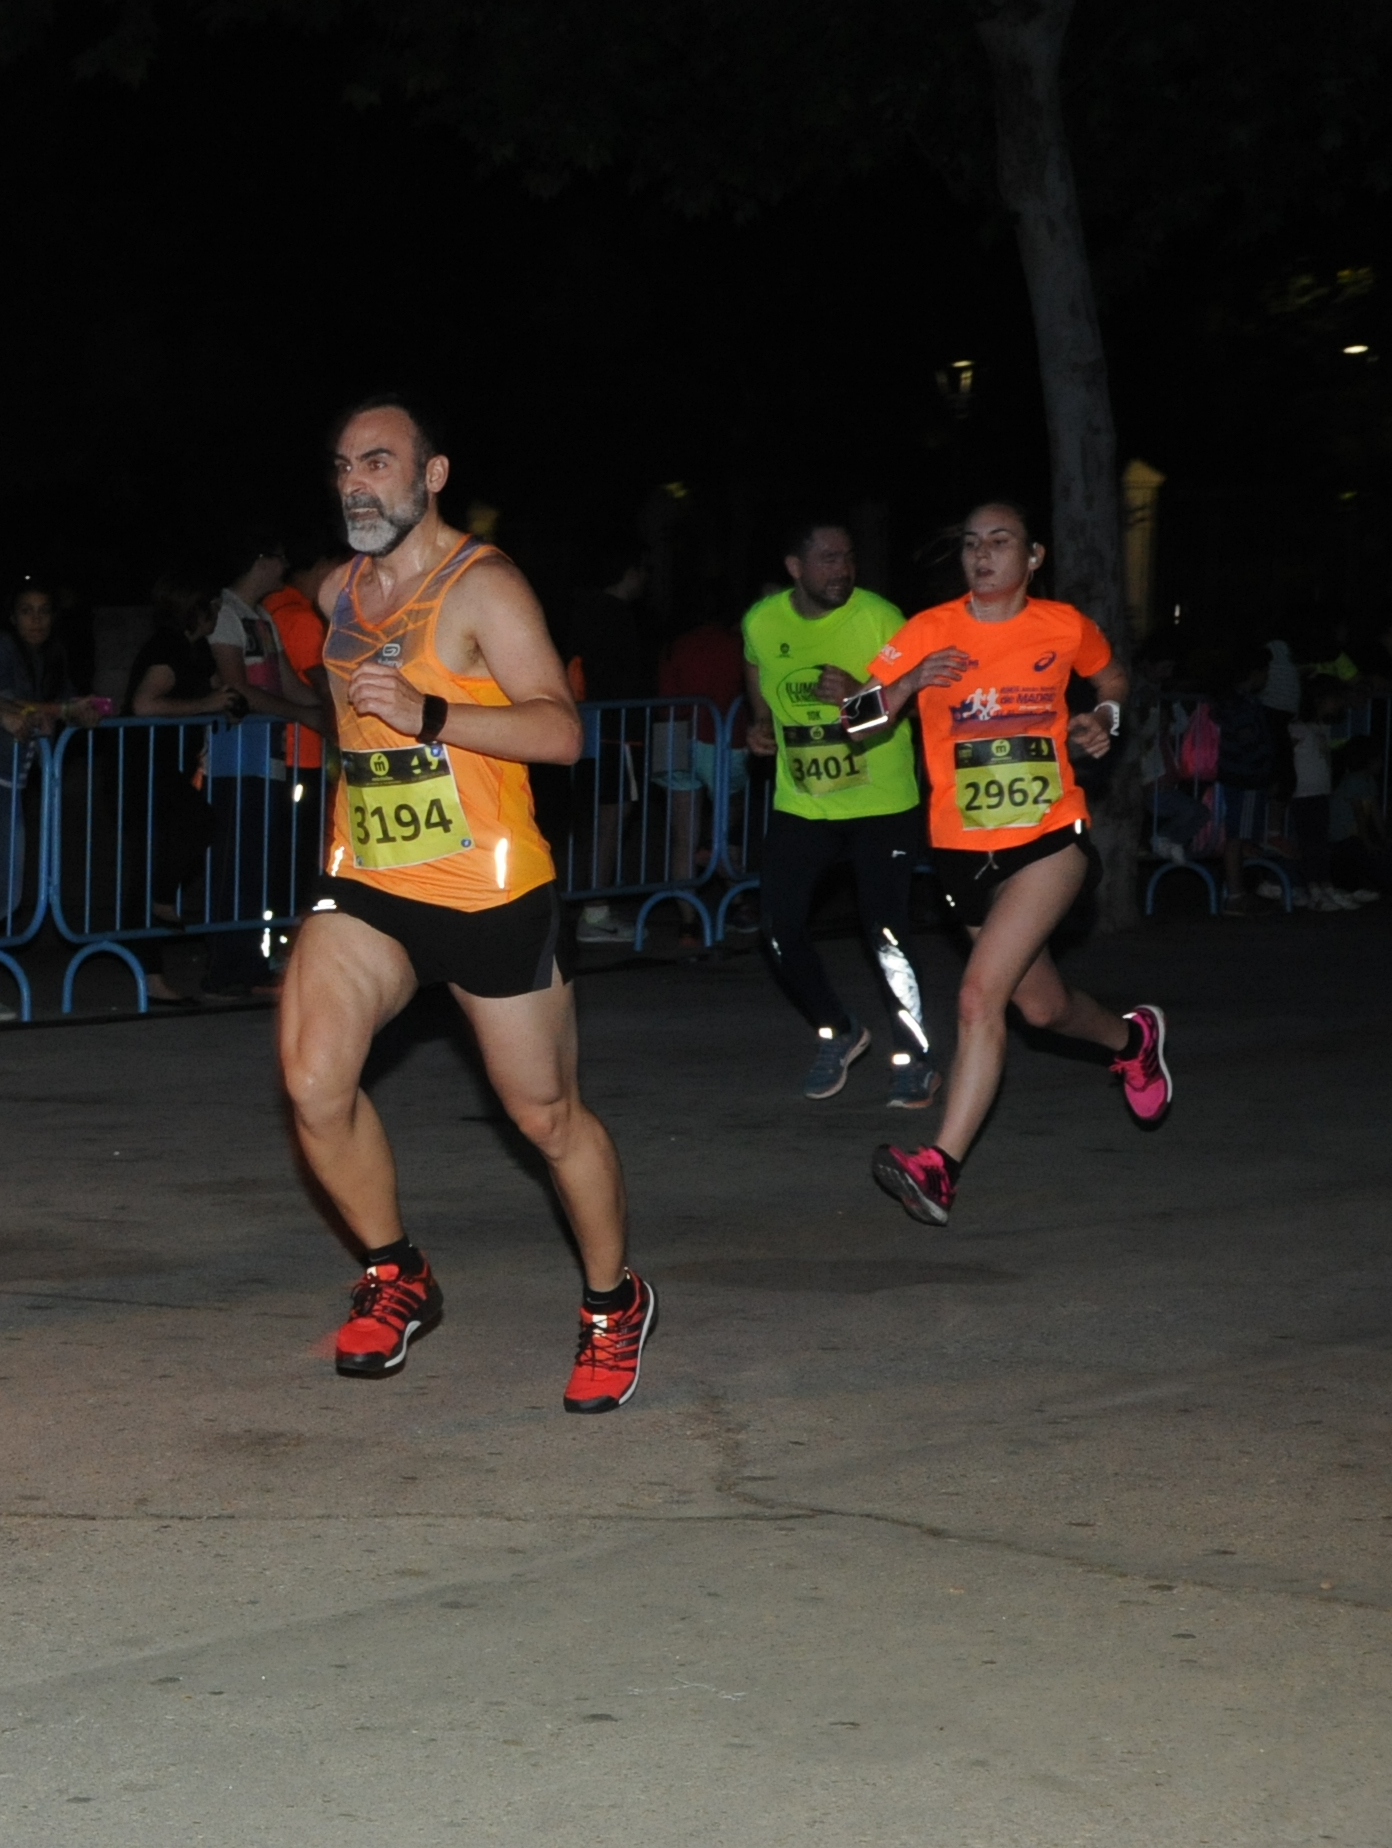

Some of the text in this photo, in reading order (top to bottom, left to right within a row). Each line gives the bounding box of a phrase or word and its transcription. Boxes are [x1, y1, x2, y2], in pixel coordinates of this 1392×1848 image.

[792, 755, 861, 782] 3401
[964, 776, 1053, 811] 2962
[354, 798, 454, 846] 3194
